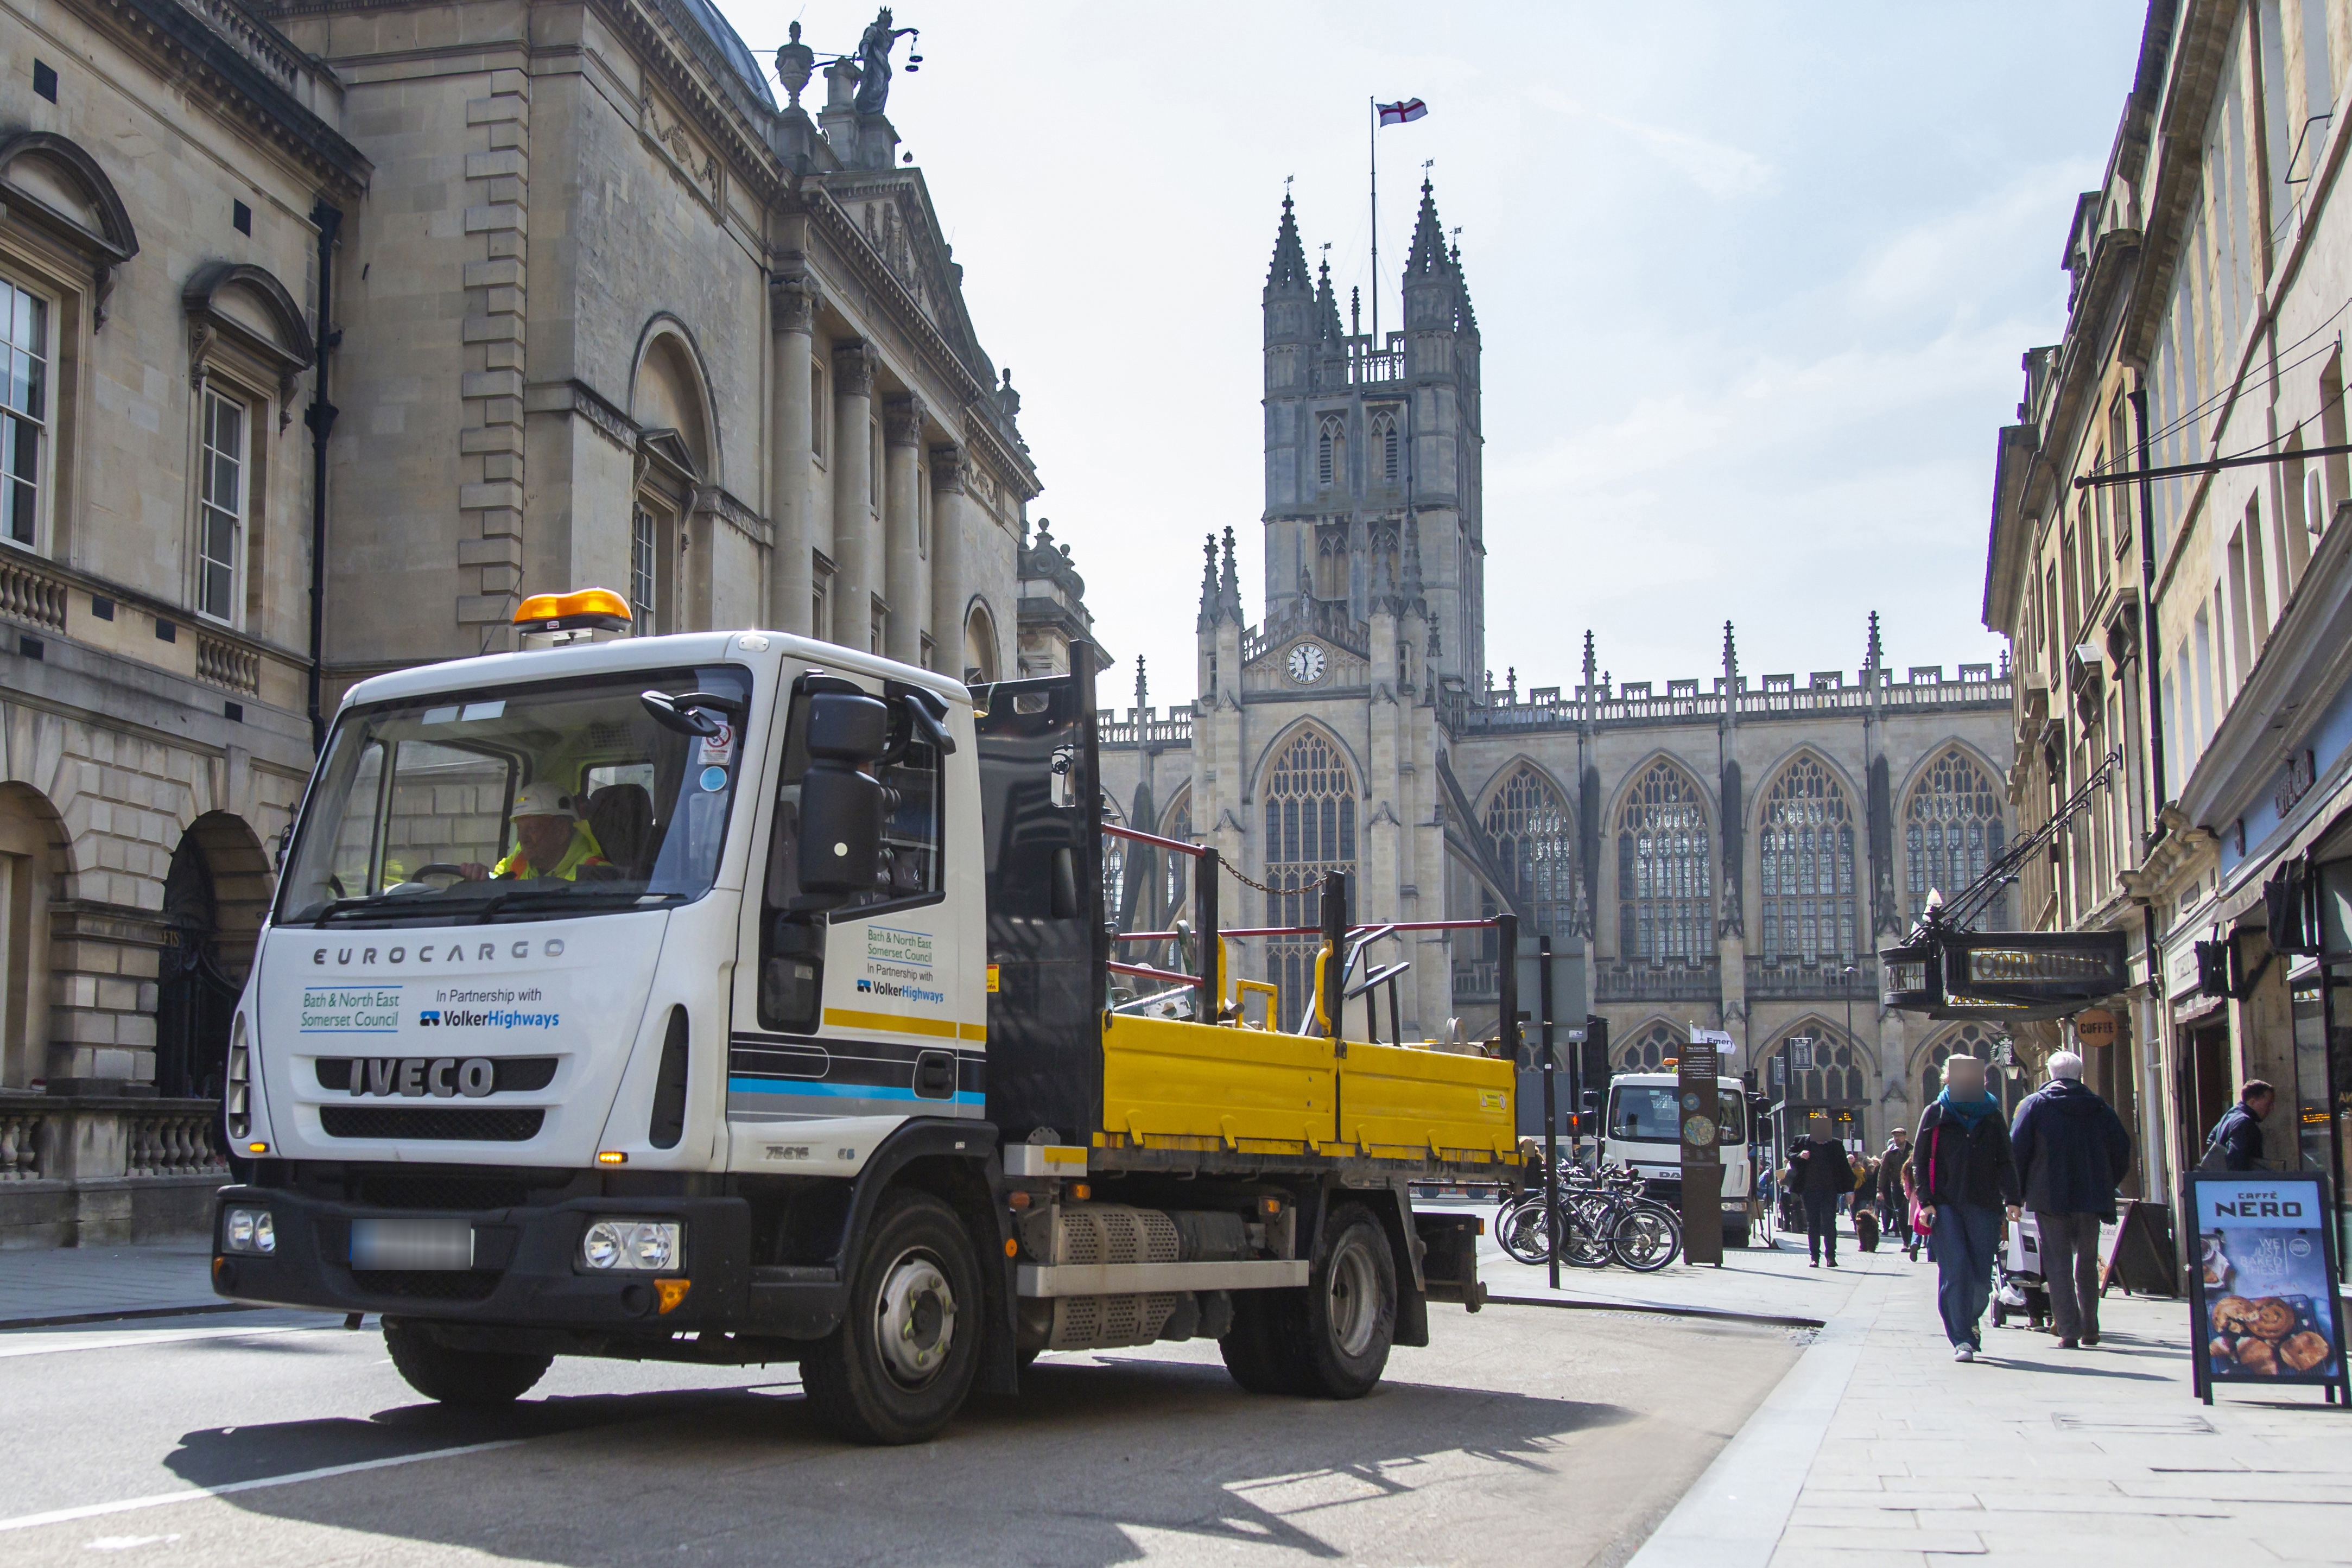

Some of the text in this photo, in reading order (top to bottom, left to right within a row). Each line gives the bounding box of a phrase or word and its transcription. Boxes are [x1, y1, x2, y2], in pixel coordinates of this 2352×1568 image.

[868, 929, 932, 949] Bath & North East
[313, 938, 565, 965] EUROCARGO
[867, 943, 933, 963] Somerset Council
[867, 962, 933, 982] In Partnership with
[303, 992, 400, 1008] Bath & North East
[436, 988, 542, 1005] In Partnership with
[873, 981, 944, 1005] VolkerHighways
[301, 1011, 398, 1027] Somerset Council
[443, 1010, 560, 1030] VolkerHighways
[2080, 1022, 2114, 1034] COFFEE
[1707, 1037, 1733, 1048] Emery
[349, 1058, 495, 1099] IVECO
[2214, 1201, 2302, 1217] NERO
[2259, 1238, 2280, 1248] WE
[2252, 1247, 2279, 1257] JUST
[2240, 1256, 2283, 1266] BAKED
[2245, 1265, 2284, 1275] THESE
